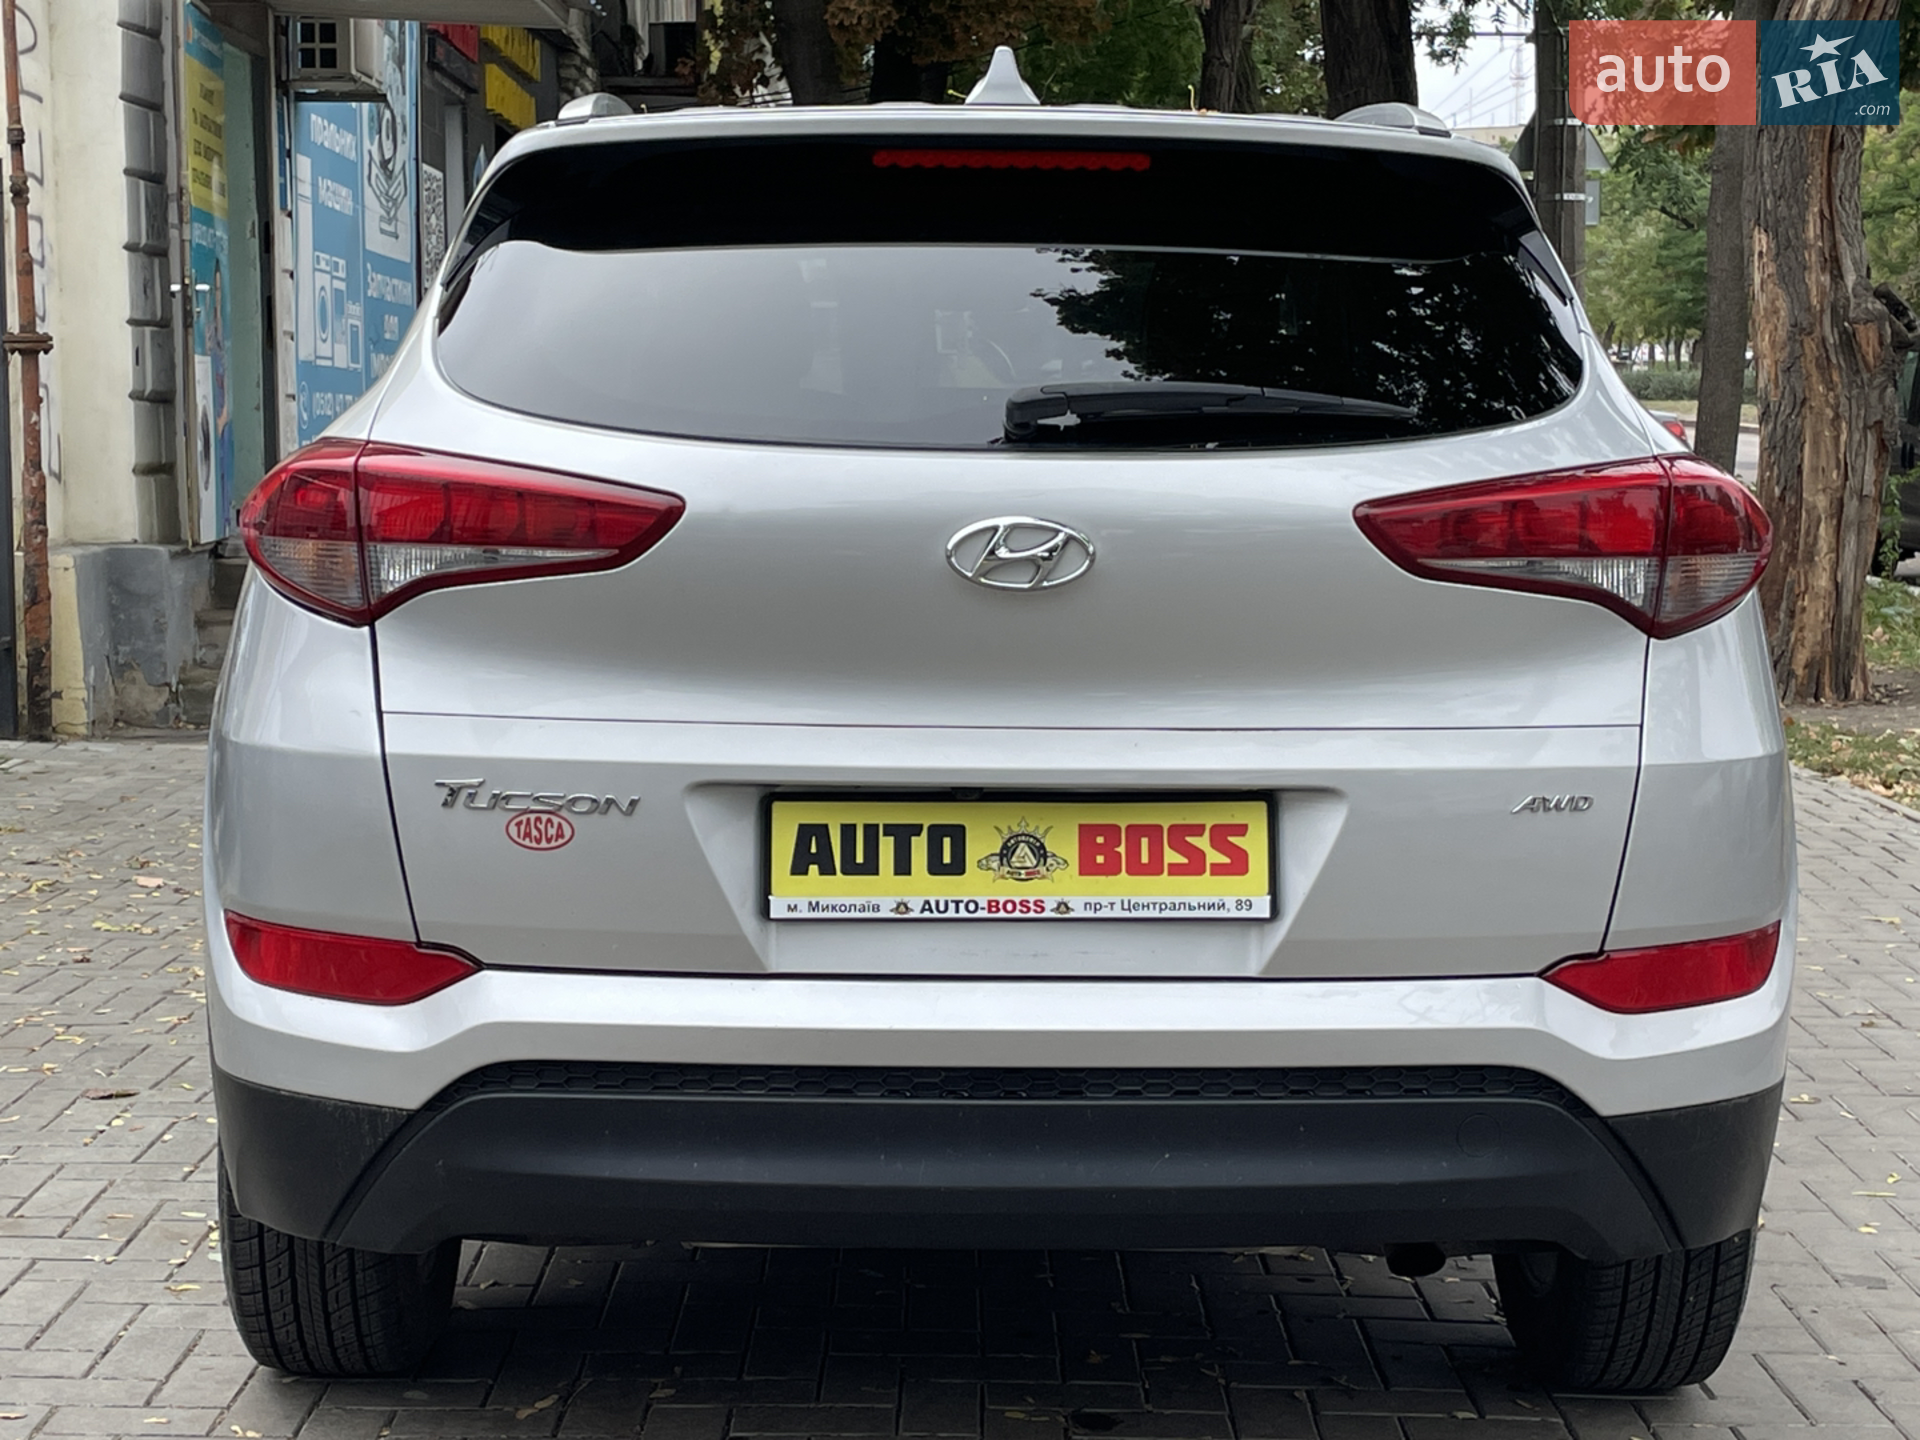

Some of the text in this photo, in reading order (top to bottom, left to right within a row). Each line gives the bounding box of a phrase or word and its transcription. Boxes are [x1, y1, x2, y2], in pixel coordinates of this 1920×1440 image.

[1511, 794, 1594, 814] AWD
[514, 816, 566, 845] TASCA
[789, 822, 1249, 877] AUTO BOSS
[807, 900, 881, 913] Миколаїв
[919, 899, 1046, 914] AUTO-BOSS
[1083, 901, 1116, 914] пр-т
[1120, 898, 1231, 915] Центральний,
[1235, 899, 1253, 912] 89
